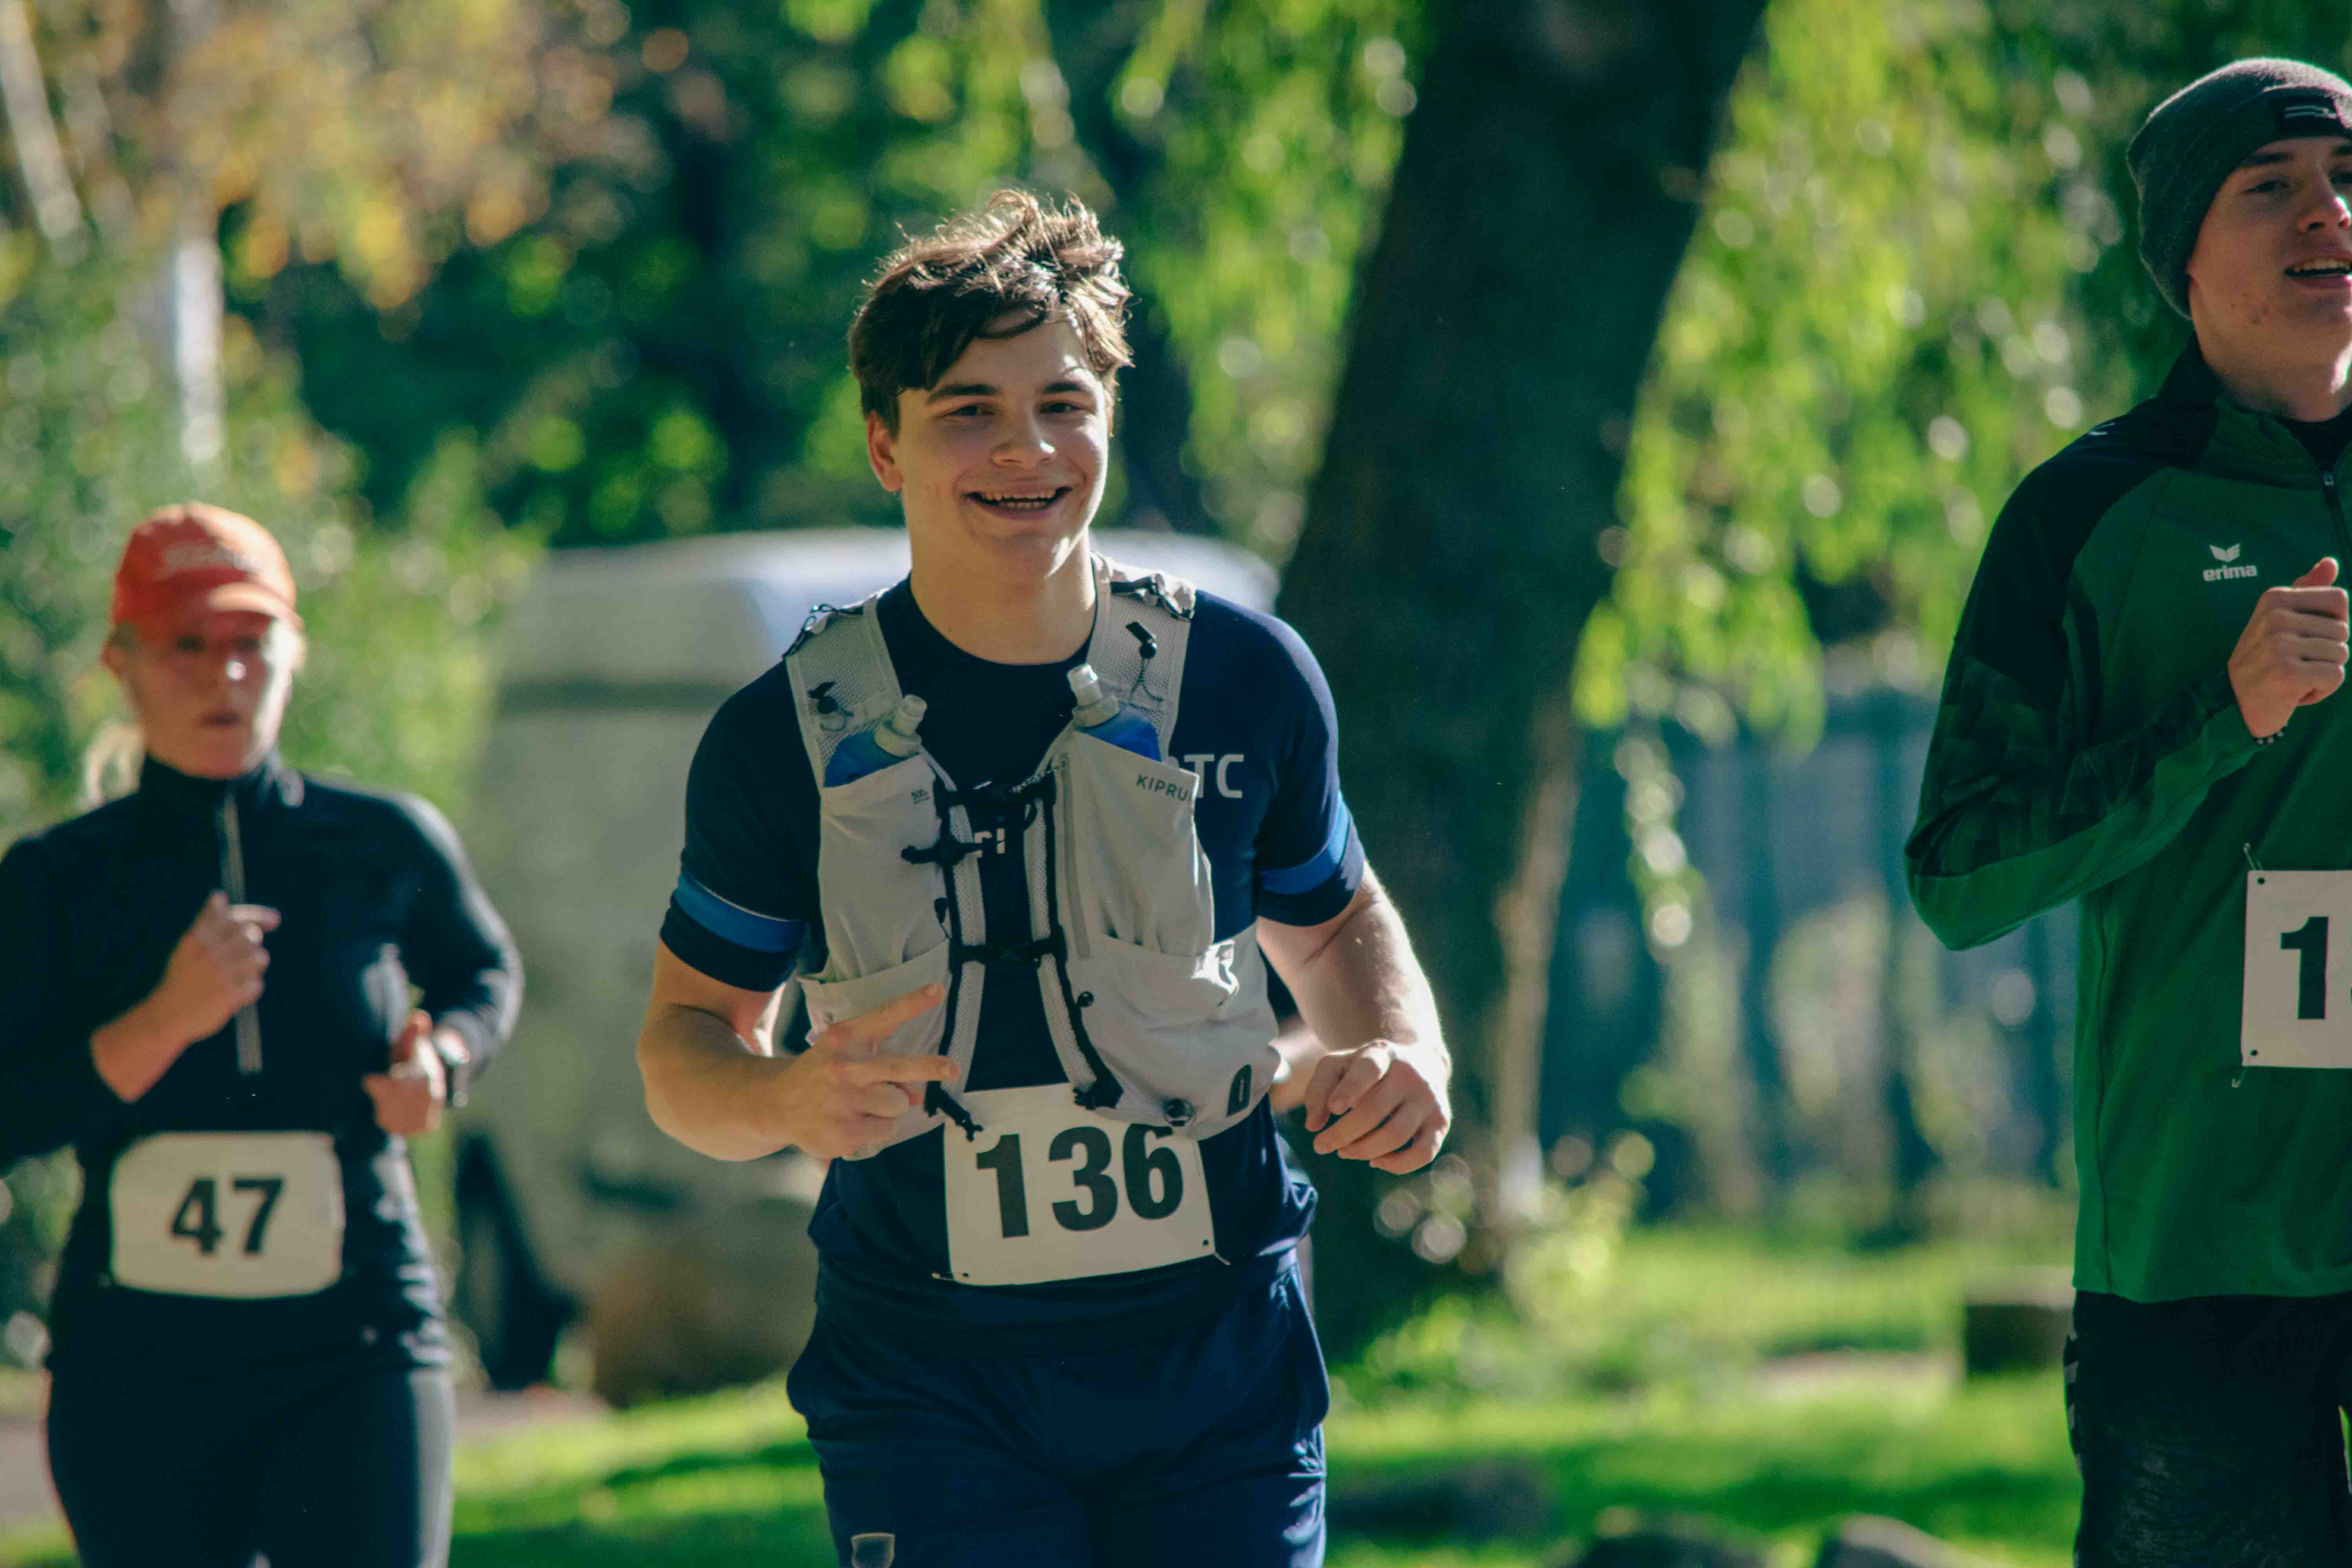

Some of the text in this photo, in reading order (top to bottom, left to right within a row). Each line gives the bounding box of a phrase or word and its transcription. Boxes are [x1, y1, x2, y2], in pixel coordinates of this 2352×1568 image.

[2203, 564, 2257, 582] erima
[1166, 754, 1244, 798] TC
[2279, 916, 2352, 1020] 1
[172, 1179, 283, 1253] 47
[976, 1123, 1183, 1239] 136
